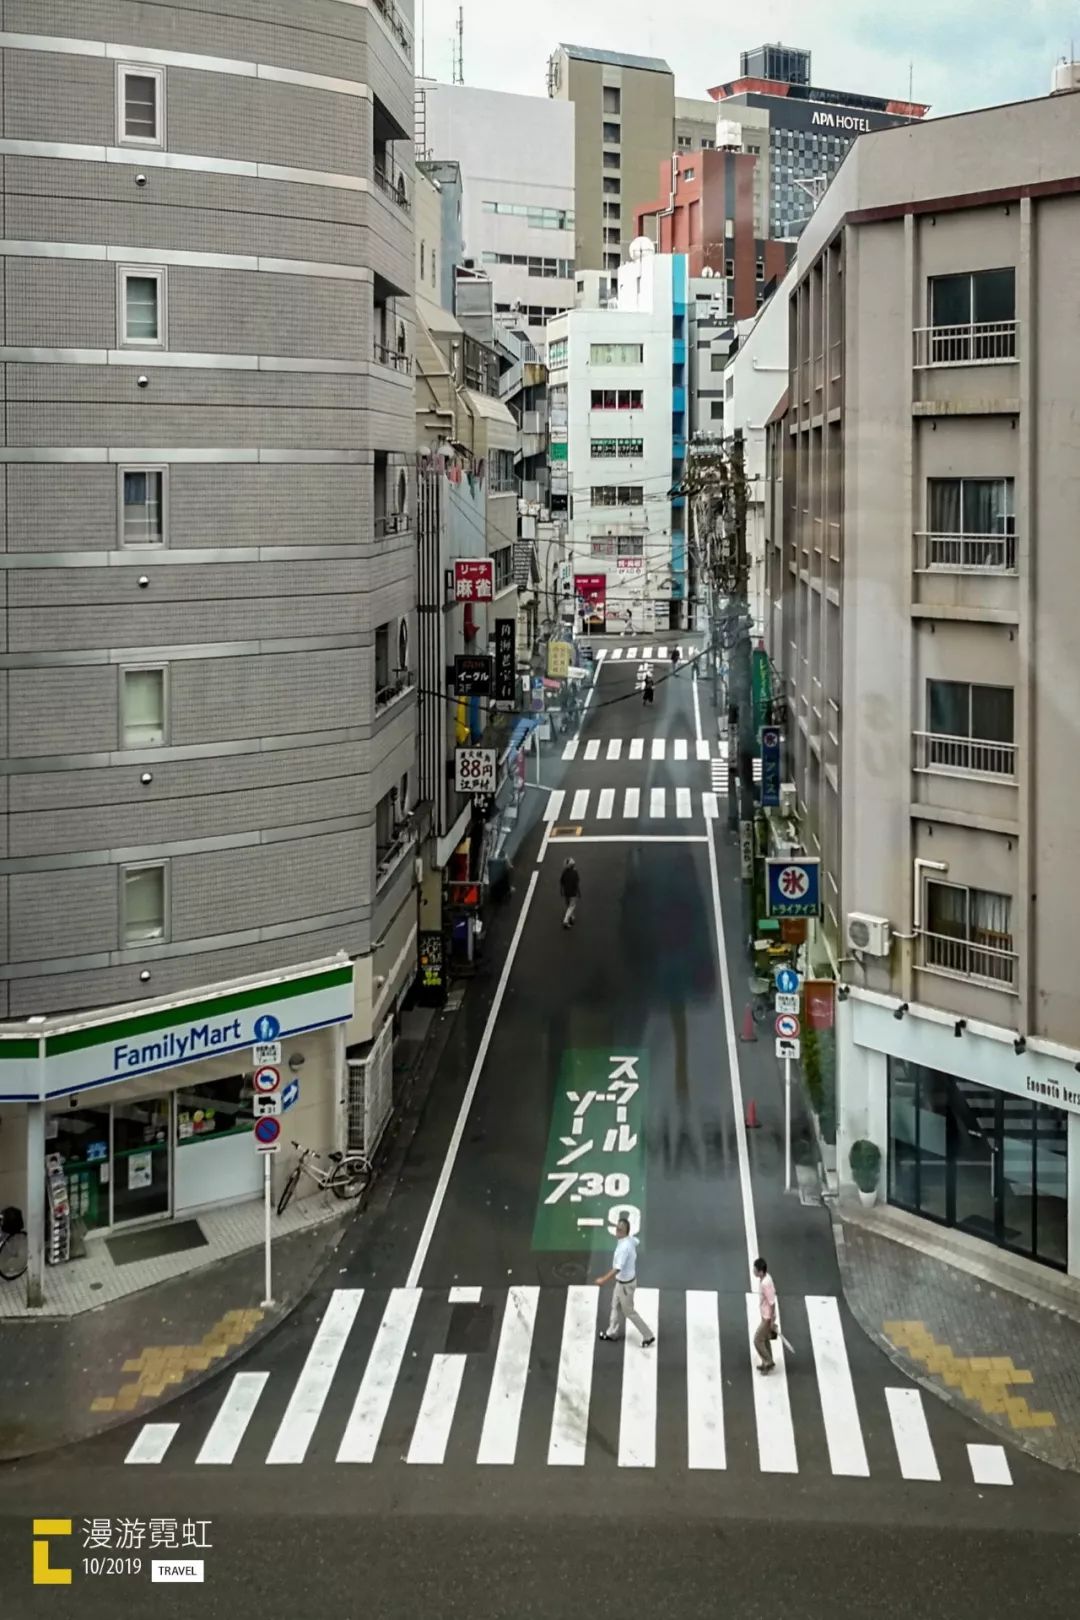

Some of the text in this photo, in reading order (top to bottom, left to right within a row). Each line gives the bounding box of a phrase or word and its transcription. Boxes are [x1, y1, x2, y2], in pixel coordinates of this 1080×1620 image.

[811, 111, 871, 132] APA HOTEL
[456, 578, 491, 598] 麻雀
[460, 759, 493, 778] 88円
[782, 869, 805, 895] 氷
[113, 1018, 242, 1070] FamilyMart
[1026, 1076, 1059, 1099] Enomoto
